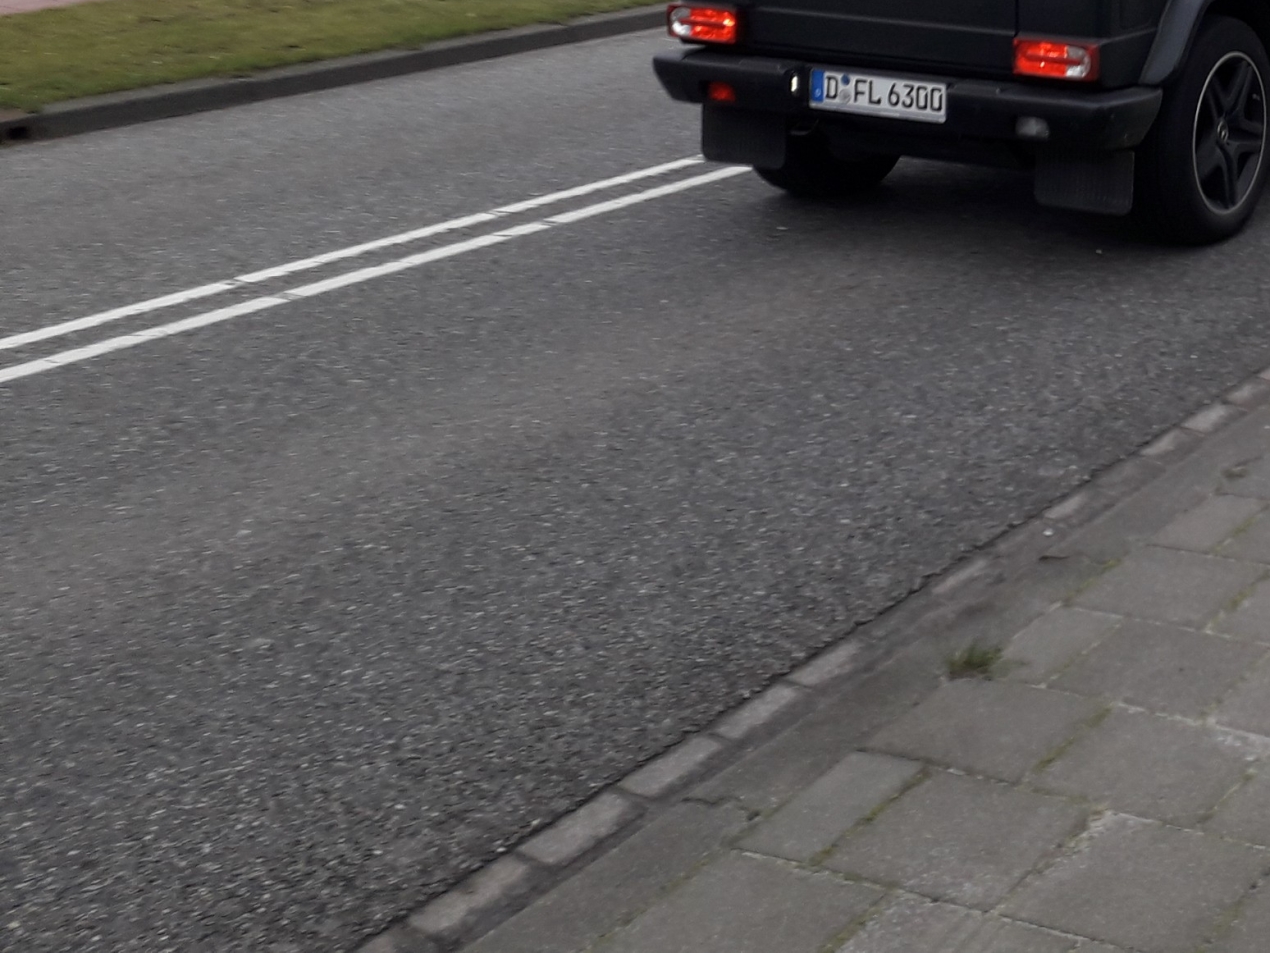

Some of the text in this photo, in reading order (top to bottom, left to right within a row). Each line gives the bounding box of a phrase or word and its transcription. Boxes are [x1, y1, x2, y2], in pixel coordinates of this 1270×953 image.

[826, 76, 943, 112] D FL 6300
